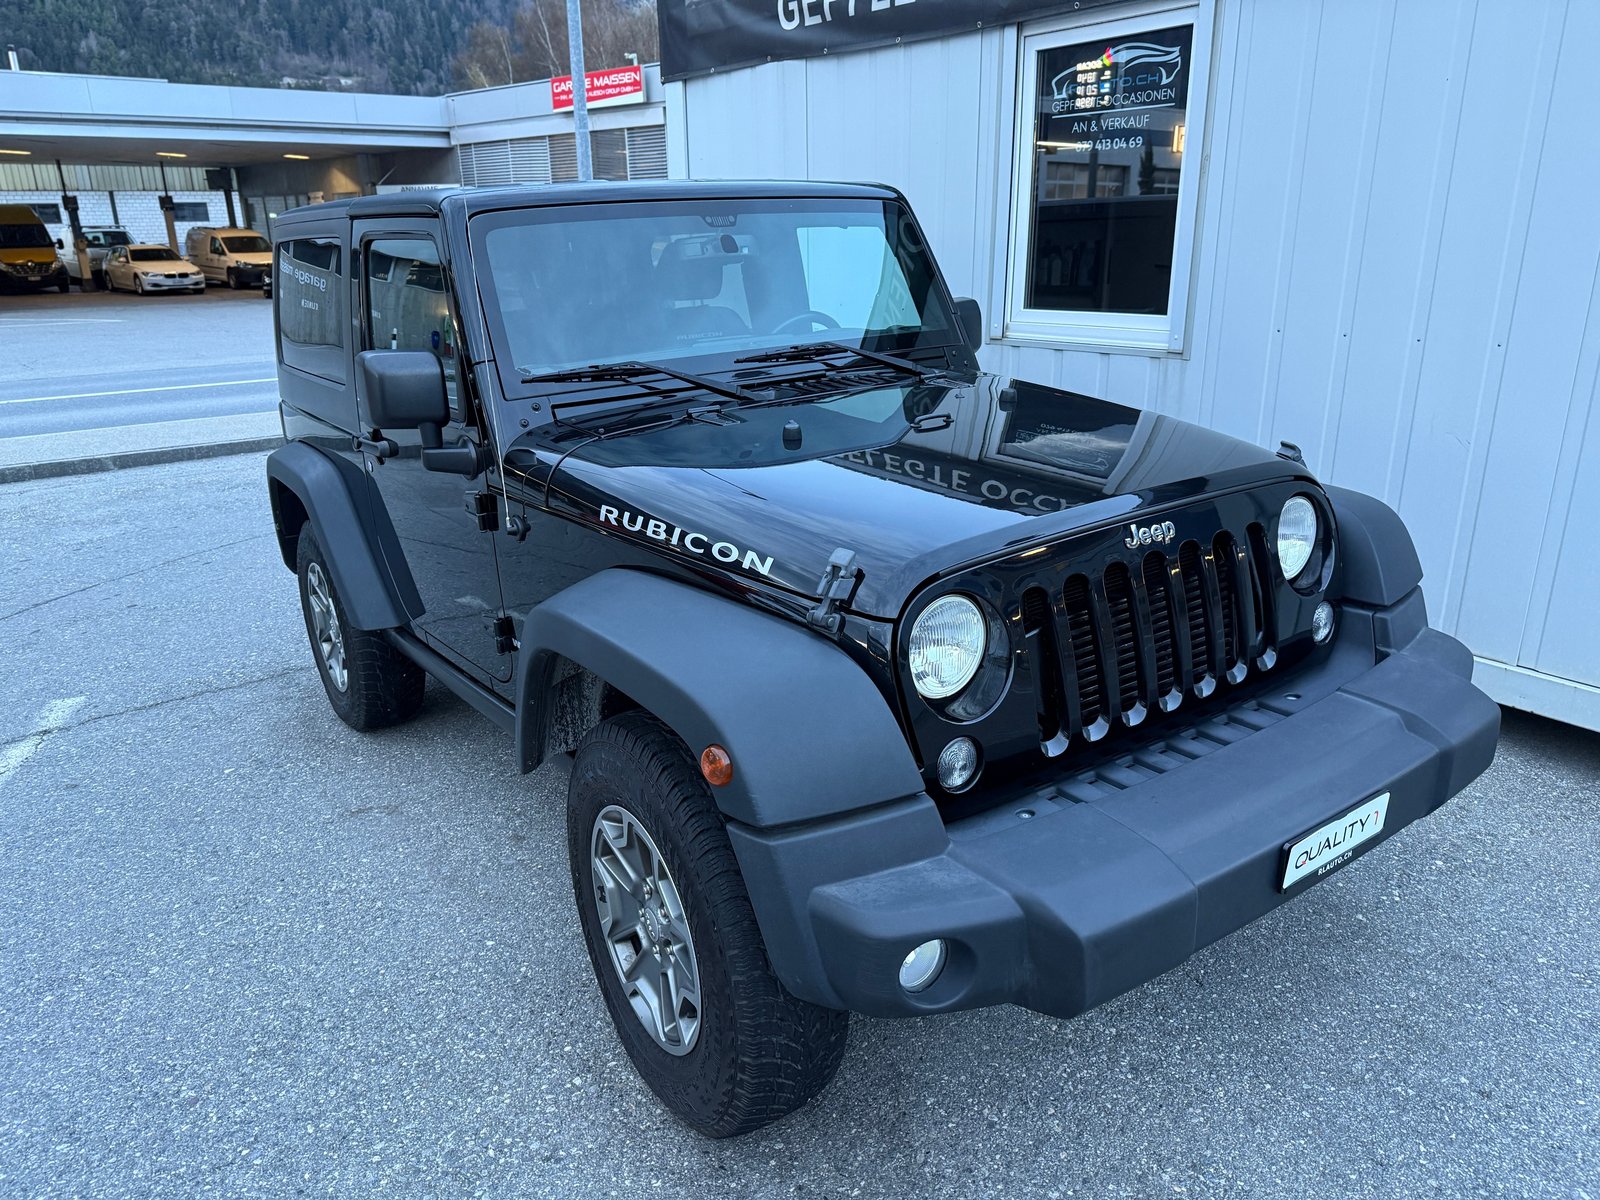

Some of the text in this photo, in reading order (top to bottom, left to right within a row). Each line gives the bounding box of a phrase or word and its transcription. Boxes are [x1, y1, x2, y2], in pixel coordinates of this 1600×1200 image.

[553, 71, 640, 93] GARE MAISSEN
[1052, 88, 1176, 113] GEPFLTE OCCASIONEN
[1072, 115, 1150, 133] AN & VERKAUF
[1095, 138, 1111, 151] 413
[1112, 137, 1127, 150] 04
[1128, 136, 1143, 148] 69
[599, 504, 775, 575] RUBICON
[1124, 521, 1176, 549] Jeep
[1294, 813, 1371, 870] QUALITY
[1317, 850, 1353, 876] RLAUTO.CH
